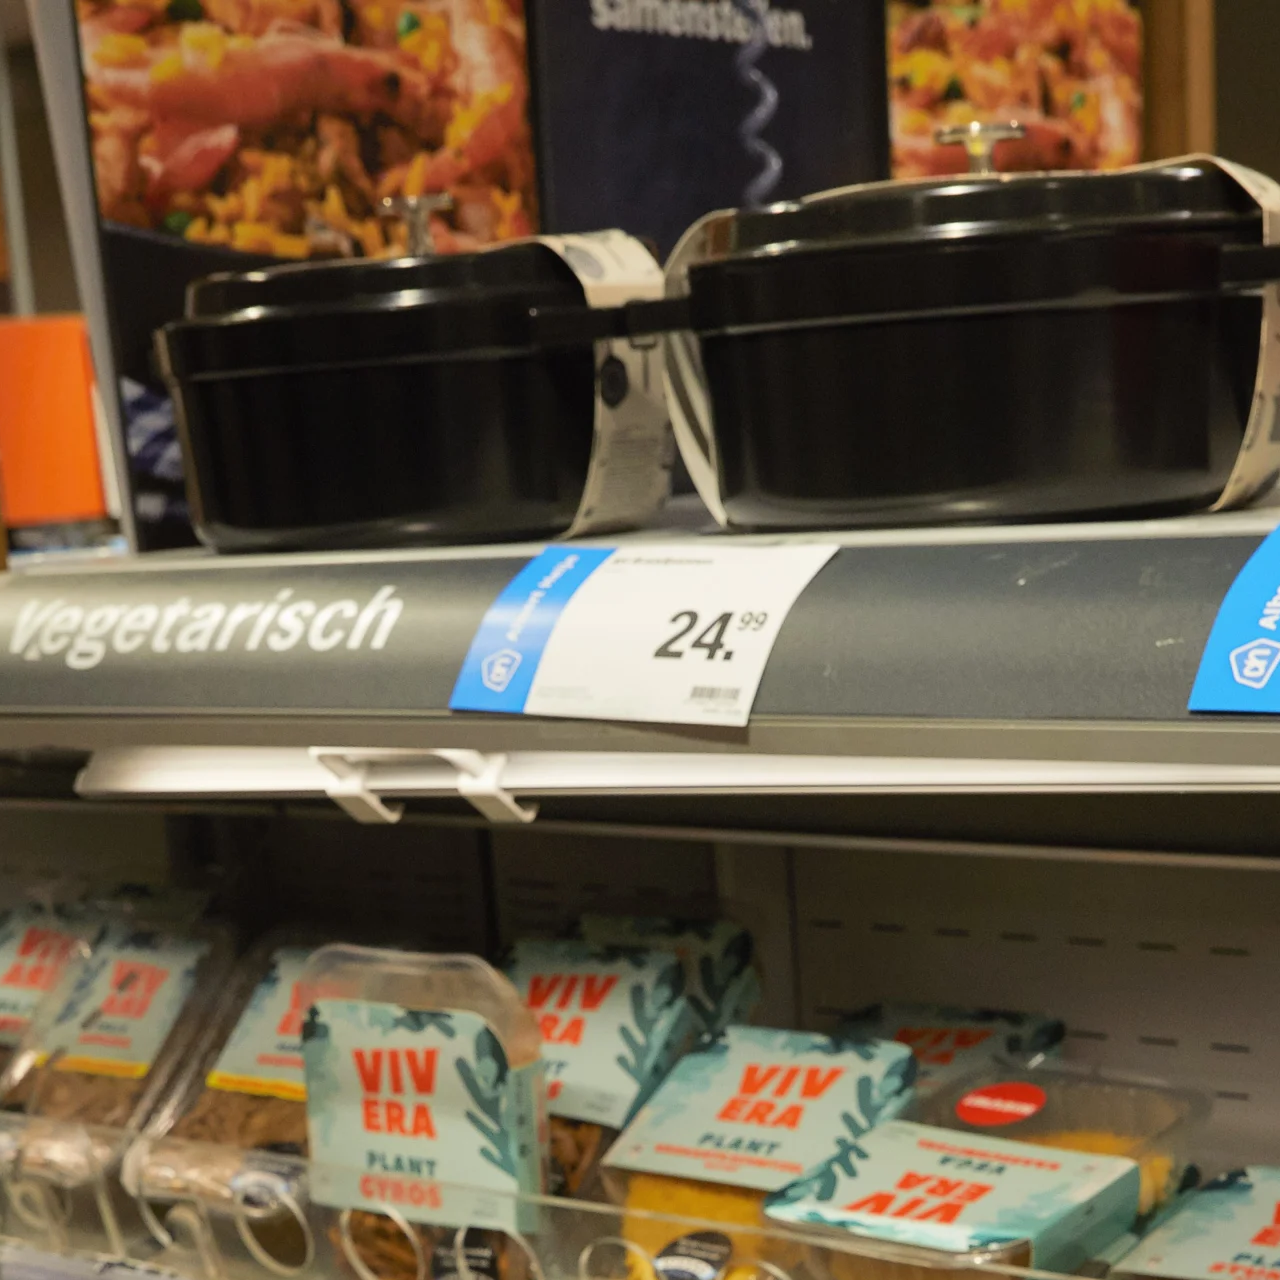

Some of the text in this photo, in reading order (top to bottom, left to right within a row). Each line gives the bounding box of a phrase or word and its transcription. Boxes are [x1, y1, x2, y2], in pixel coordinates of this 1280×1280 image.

[590, 0, 813, 49] samensteen.
[9, 584, 404, 670] Vegetarisch
[654, 610, 769, 661] 24.99
[527, 973, 619, 1013] VIV
[538, 1015, 587, 1047] RA
[352, 1047, 441, 1097] VIV
[738, 1063, 847, 1100] VIV
[362, 1099, 437, 1140] ERA
[717, 1096, 805, 1130] ERA
[366, 1149, 438, 1178] PLANT
[698, 1133, 782, 1157] PLANT
[894, 1170, 995, 1204] ERA
[843, 1190, 967, 1225] VIV
